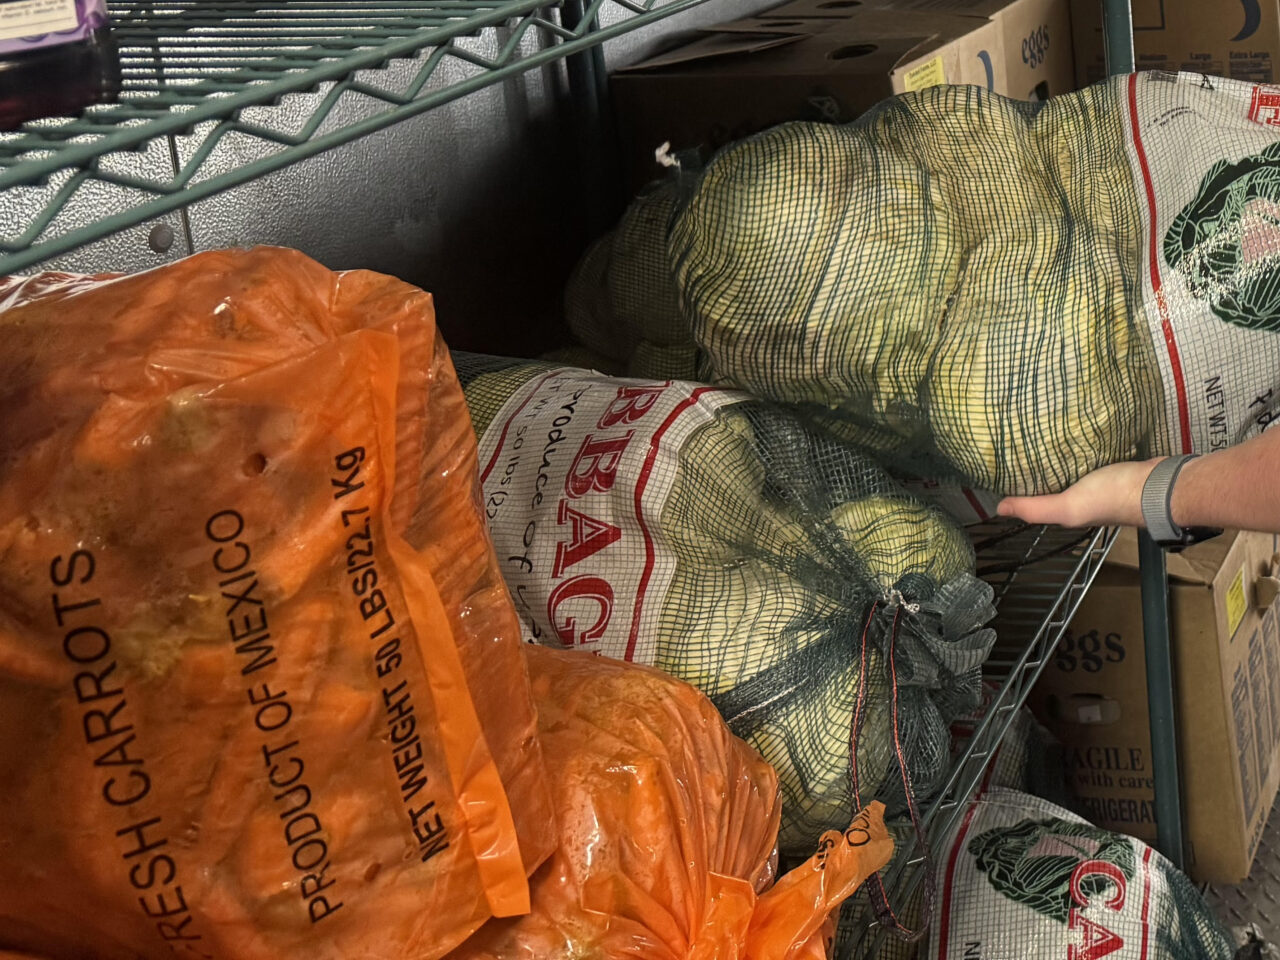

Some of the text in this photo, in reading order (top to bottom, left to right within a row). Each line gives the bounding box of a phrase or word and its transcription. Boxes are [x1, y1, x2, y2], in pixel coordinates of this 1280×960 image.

[1022, 24, 1050, 70] eggs
[1203, 375, 1225, 410] NET
[511, 425, 530, 451] 50
[1208, 412, 1228, 440] WT
[331, 445, 367, 500] Kg
[500, 455, 526, 490] lbs
[548, 380, 674, 656] BBAG
[508, 520, 536, 574] of
[375, 636, 404, 680] 50
[1053, 628, 1127, 673] ggs
[204, 508, 345, 925] PRODUCT OF MEXICO
[49, 548, 204, 954] RESH CARROTS
[381, 679, 429, 803] WEIGHT
[1078, 771, 1113, 787] with
[409, 799, 452, 864] NET
